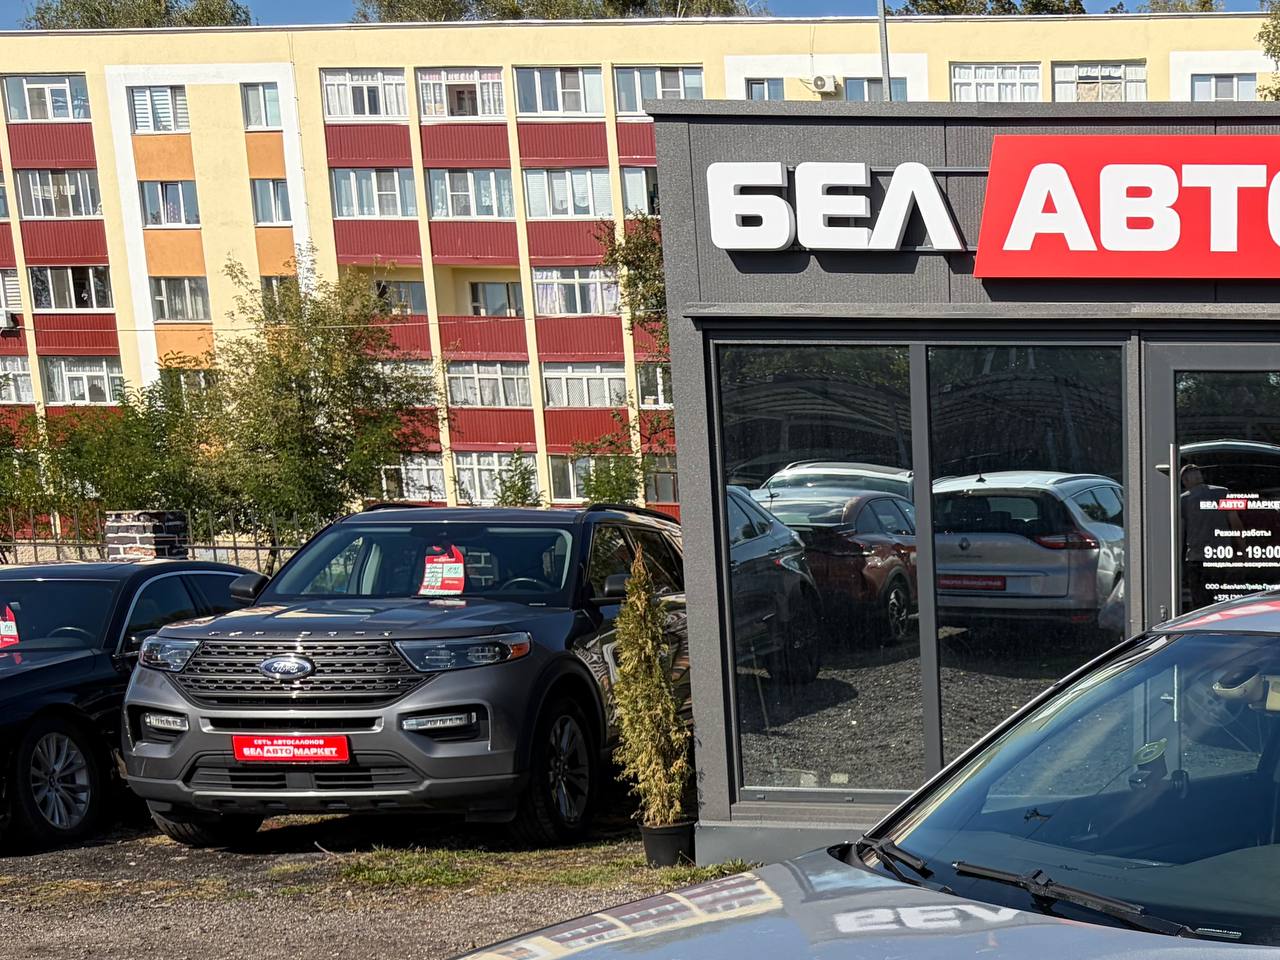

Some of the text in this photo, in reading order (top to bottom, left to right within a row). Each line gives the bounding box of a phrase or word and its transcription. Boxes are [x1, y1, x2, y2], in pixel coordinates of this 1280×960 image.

[706, 161, 966, 252] БЕЛ
[1200, 500, 1219, 510] БЕЛ
[1220, 501, 1246, 509] АВТО
[1241, 529, 1272, 539] работы
[1203, 545, 1234, 559] 9:00
[270, 660, 300, 674] Ford
[243, 747, 338, 756] БЕЛ АВТО МАРКЕТ
